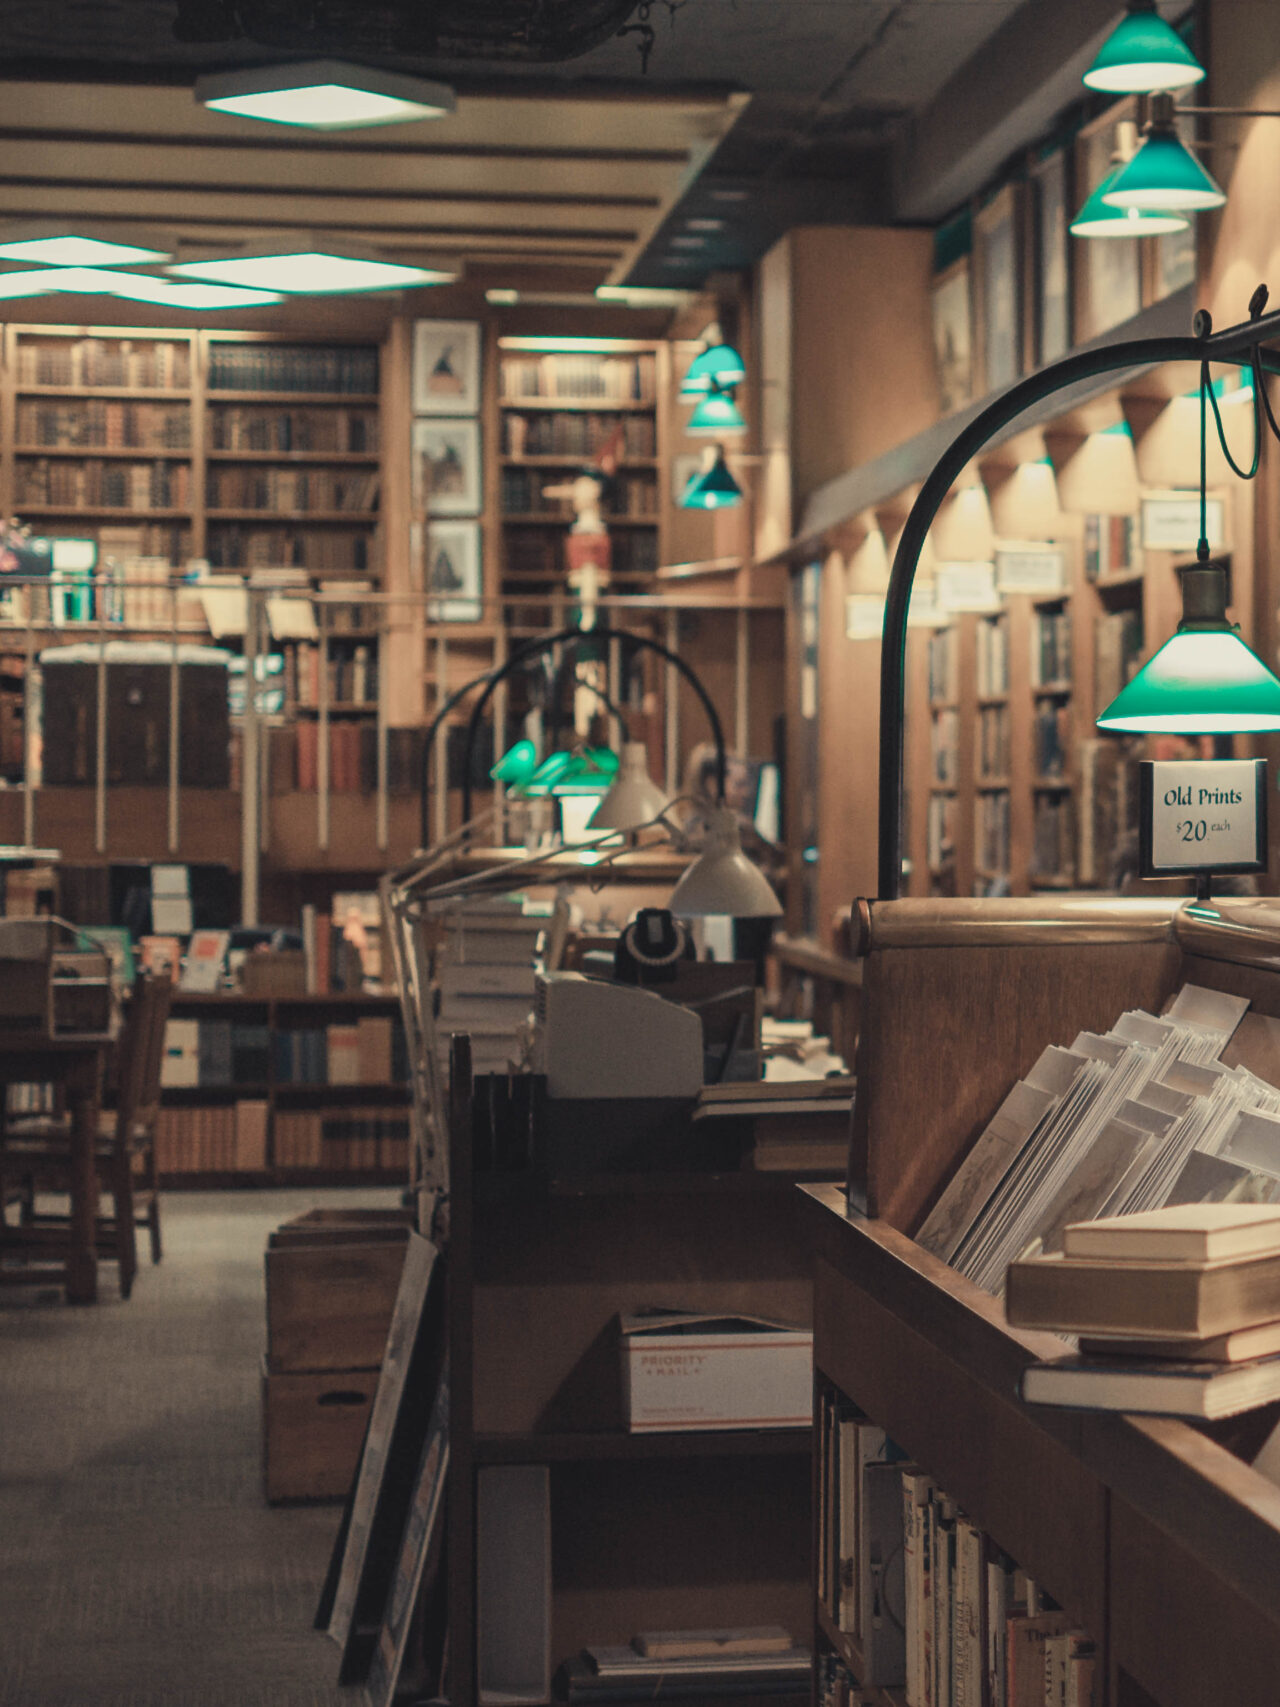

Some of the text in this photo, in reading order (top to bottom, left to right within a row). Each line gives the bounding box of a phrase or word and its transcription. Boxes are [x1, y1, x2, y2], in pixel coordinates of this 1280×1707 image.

[1164, 786, 1242, 806] Old Prints
[1211, 819, 1231, 832] each
[641, 1355, 705, 1366] PRIORITY
[656, 1368, 689, 1376] MAIL
